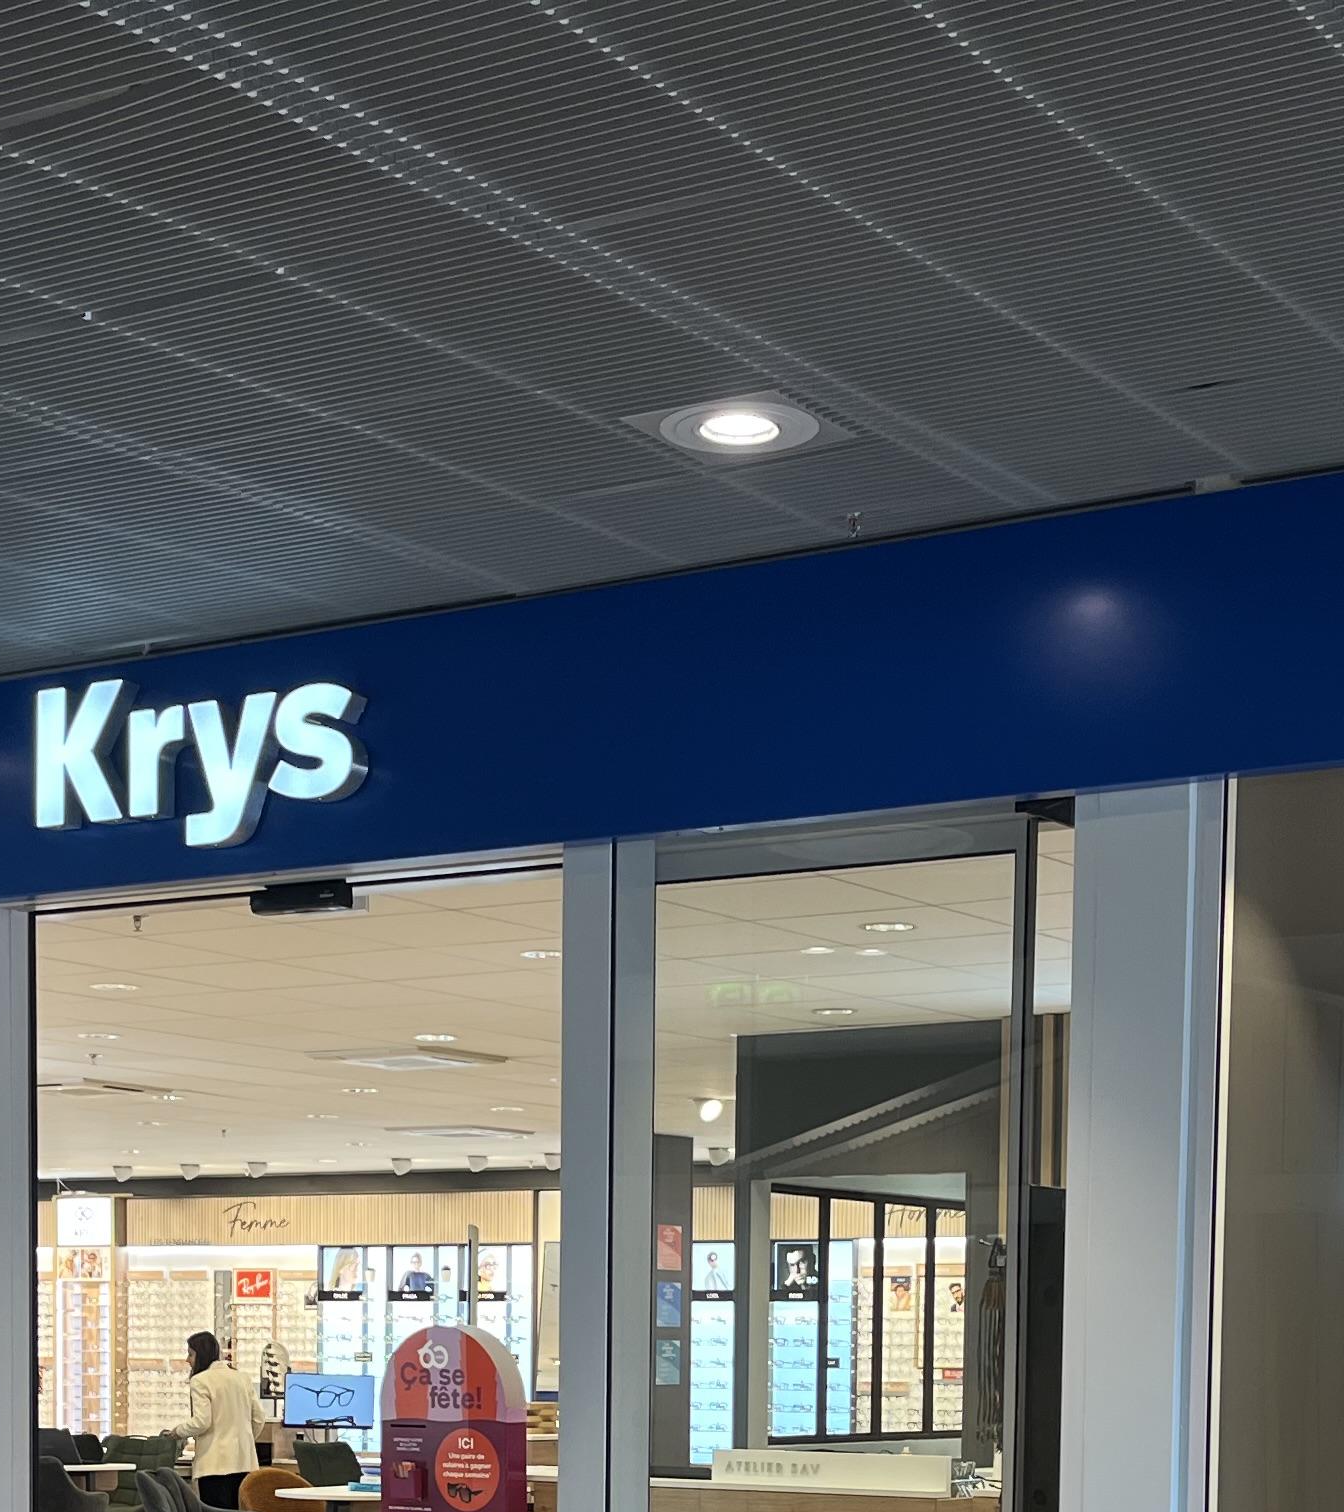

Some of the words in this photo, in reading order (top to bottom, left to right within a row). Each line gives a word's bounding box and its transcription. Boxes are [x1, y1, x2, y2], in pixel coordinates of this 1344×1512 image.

[35, 678, 364, 848] Krys
[222, 1201, 291, 1238] Femme
[399, 1361, 433, 1391] Ça
[439, 1367, 465, 1386] se
[429, 1386, 483, 1409] fête!
[457, 1437, 474, 1450] ICI
[725, 1460, 784, 1474] ATELIER
[790, 1462, 821, 1475] SAV
